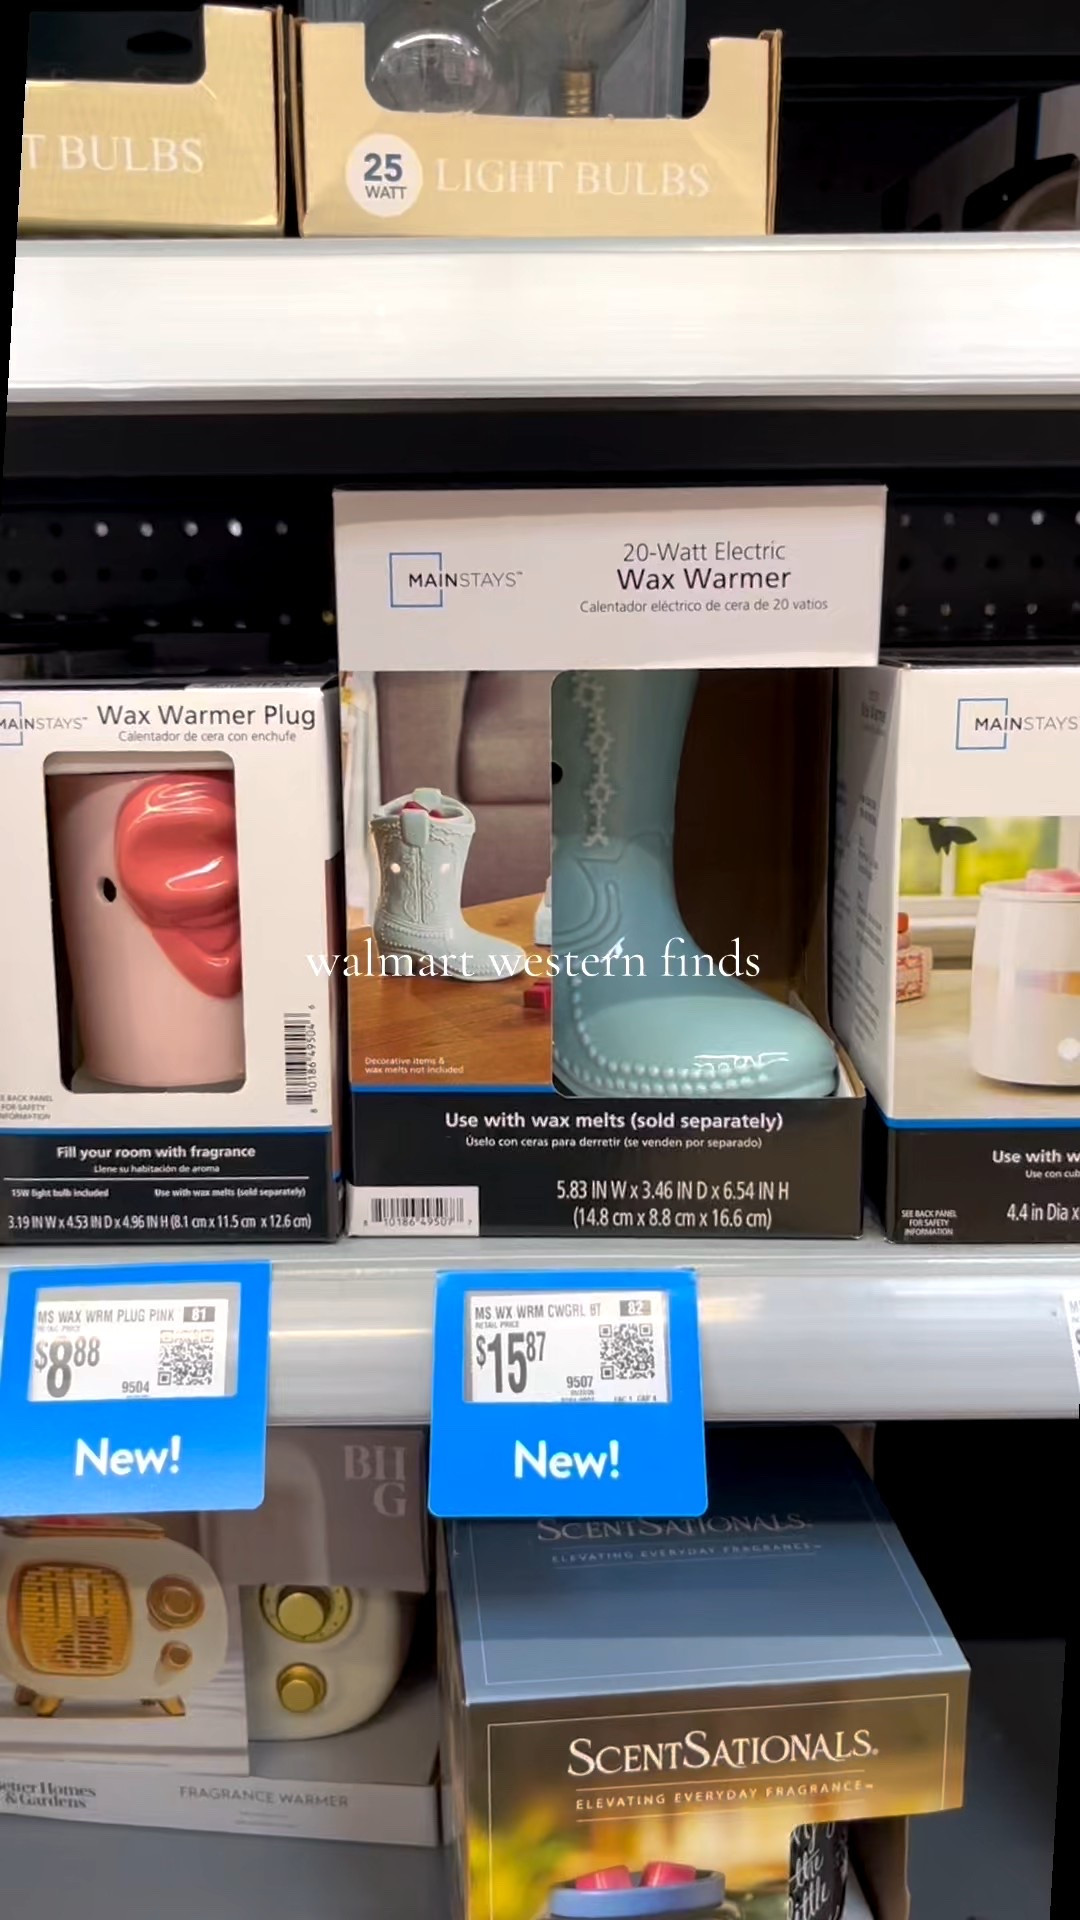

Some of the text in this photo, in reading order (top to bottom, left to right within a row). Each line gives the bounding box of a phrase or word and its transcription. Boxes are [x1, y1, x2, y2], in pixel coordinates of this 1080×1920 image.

[60, 134, 204, 174] BULBS
[363, 153, 403, 182] 25
[436, 158, 710, 197] LIGHT BULBS
[365, 185, 407, 200] WATT
[623, 539, 785, 563] 20-Watt Electric
[616, 567, 791, 590] Wax Warmer
[580, 598, 828, 613] Calentador eléctrico de cera de 20 vatios
[97, 704, 315, 730] Wax Warmer Plug
[118, 730, 297, 742] Calentador de cera con enchufe
[365, 1057, 410, 1065] Decorative
[427, 1065, 463, 1073] included
[445, 1112, 783, 1132] Use with wax melts (sold separately)
[466, 1135, 762, 1149] Úselo con ceras para derretir (se venden por separado)
[56, 1146, 256, 1161] Fill your room with fragrance
[992, 1149, 1062, 1163] Use with
[132, 1165, 177, 1173] habitación
[179, 1165, 190, 1173] de
[1026, 1170, 1042, 1178] Use
[12, 1189, 29, 1197] 15W
[154, 1189, 170, 1197] Use
[172, 1188, 191, 1197] with
[212, 1188, 235, 1197] melts
[237, 1188, 258, 1197] (sold
[260, 1187, 306, 1198] separately)
[557, 1180, 789, 1200] 5.83 IN W x 3.46 IN D x 6.54 IN H
[573, 1206, 772, 1230] (14.8 cm x 8.8 cm x 16.6 cm)
[915, 1210, 934, 1218] BACK
[1007, 1202, 1069, 1221] 4.4 in Dia
[8, 1213, 312, 1230] 3.19 IN W 4.53 IN D 4.96 IN H (8.1 cm 11.5 cm 12.6 cm)
[909, 1219, 949, 1227] FOR SAFETY
[905, 1228, 954, 1236] INFORMATION
[38, 1310, 54, 1324] MS
[58, 1310, 81, 1324] WAX
[86, 1309, 113, 1323] WRM
[117, 1308, 145, 1322] PLUG
[150, 1308, 175, 1321] PINK
[475, 1307, 491, 1320] MS
[496, 1306, 513, 1319] WX
[517, 1305, 544, 1318] WRM
[548, 1304, 585, 1317] CWGRL
[121, 1381, 149, 1393] 9504
[566, 1376, 593, 1388] 9507
[75, 1435, 182, 1476] New!
[514, 1440, 620, 1479] New!
[374, 1482, 406, 1517] G
[180, 1785, 348, 1808] FRAGRANCE WARMER
[576, 1794, 666, 1810] ELEVATING
[674, 1788, 757, 1803] EVERYDAY
